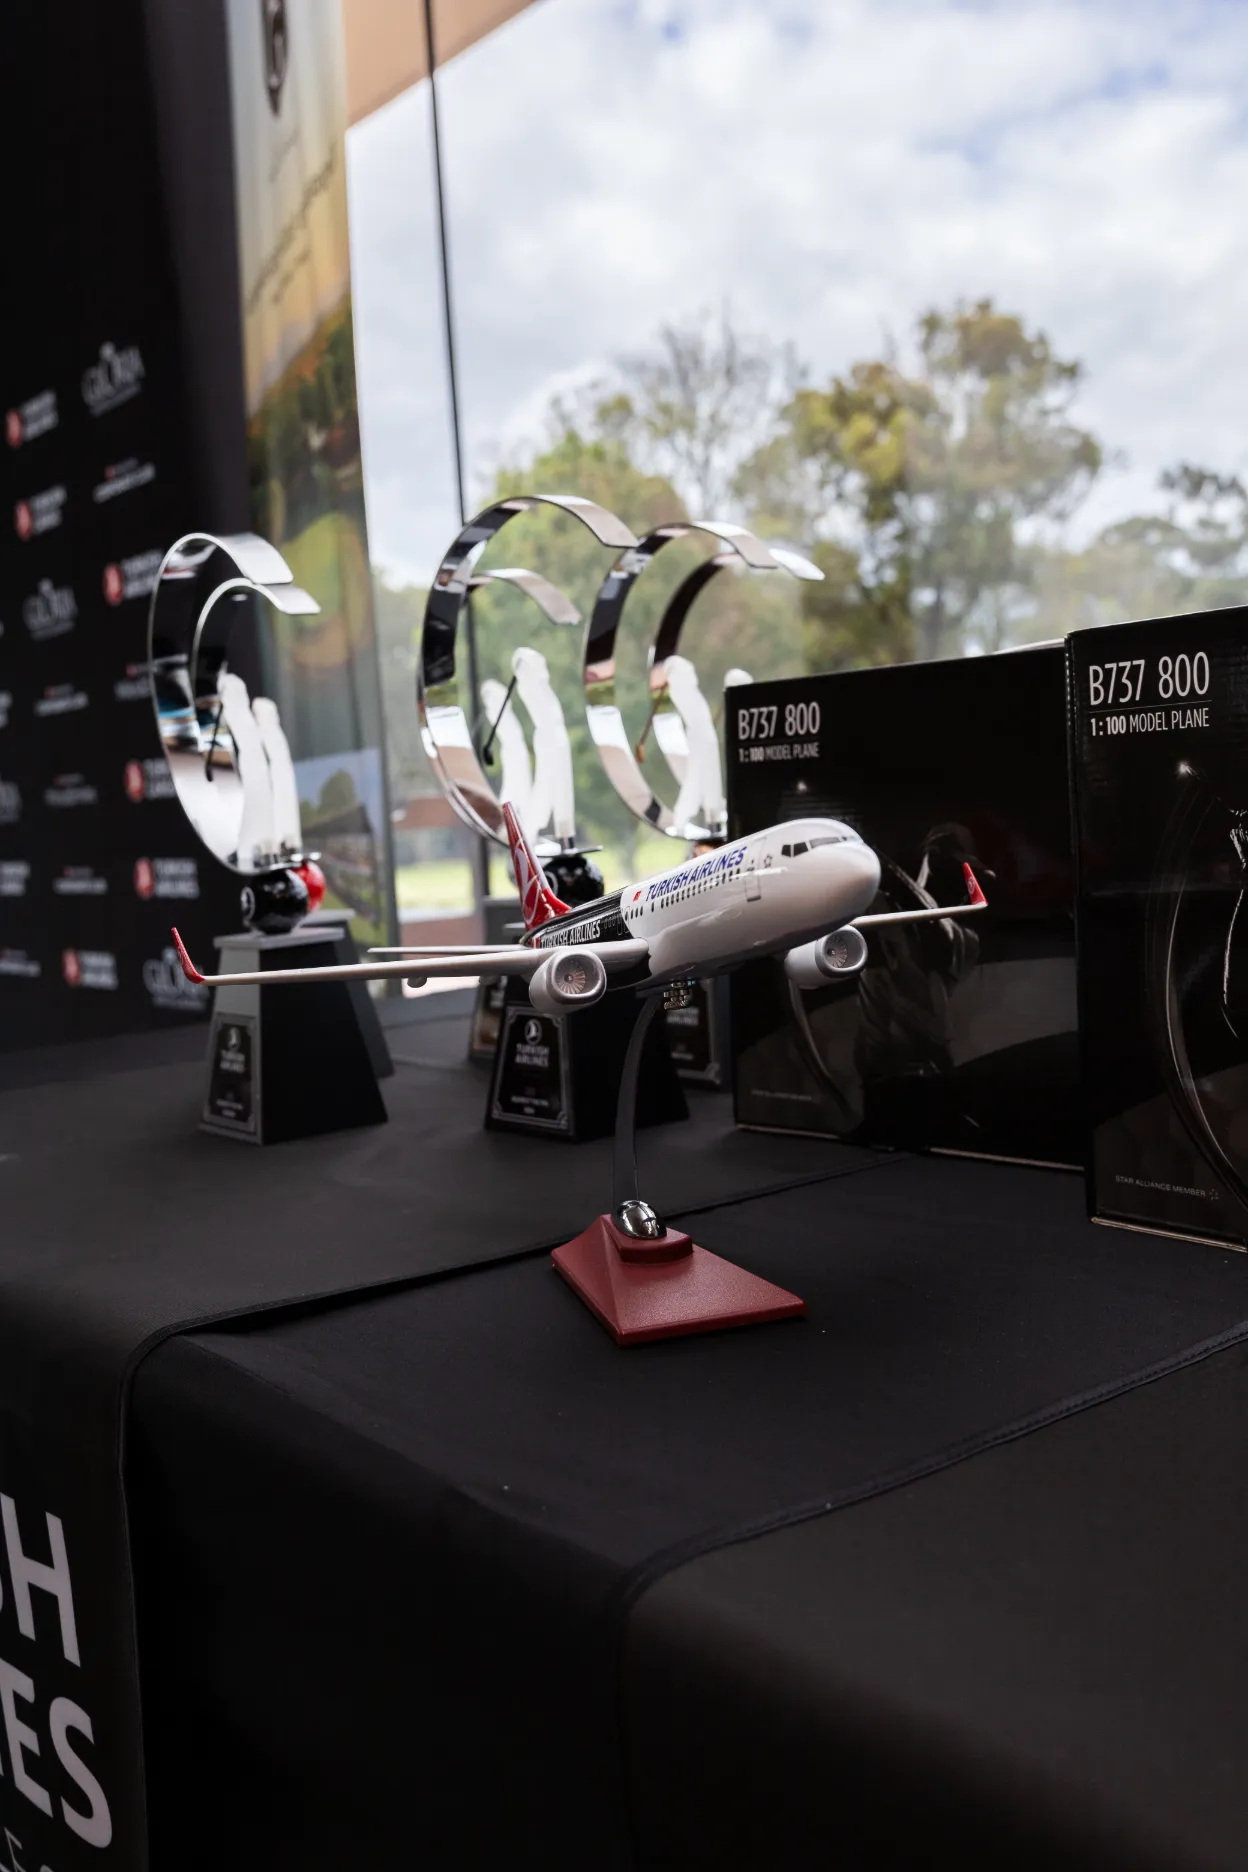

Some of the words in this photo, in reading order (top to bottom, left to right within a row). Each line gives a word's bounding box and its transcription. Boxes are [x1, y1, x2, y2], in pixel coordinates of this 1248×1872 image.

[1089, 659, 1145, 706] B737
[1158, 652, 1210, 698] 800
[738, 706, 778, 740] B737
[785, 702, 820, 736] 800
[1129, 711, 1168, 733] MODEL
[1171, 708, 1210, 730] PLANE
[766, 744, 791, 760] MODEL
[793, 742, 819, 758] PLANE
[646, 869, 692, 901] TURKISH
[688, 846, 747, 884] AIRLINES
[541, 930, 569, 948] TURKISH
[570, 920, 600, 945] AIRLINES
[1115, 1175, 1134, 1184] STAR
[1135, 1179, 1171, 1191] ALLIANCE
[1172, 1185, 1206, 1197] MEMBER
[0, 1492, 81, 1668] H
[0, 1658, 112, 1848] ES
